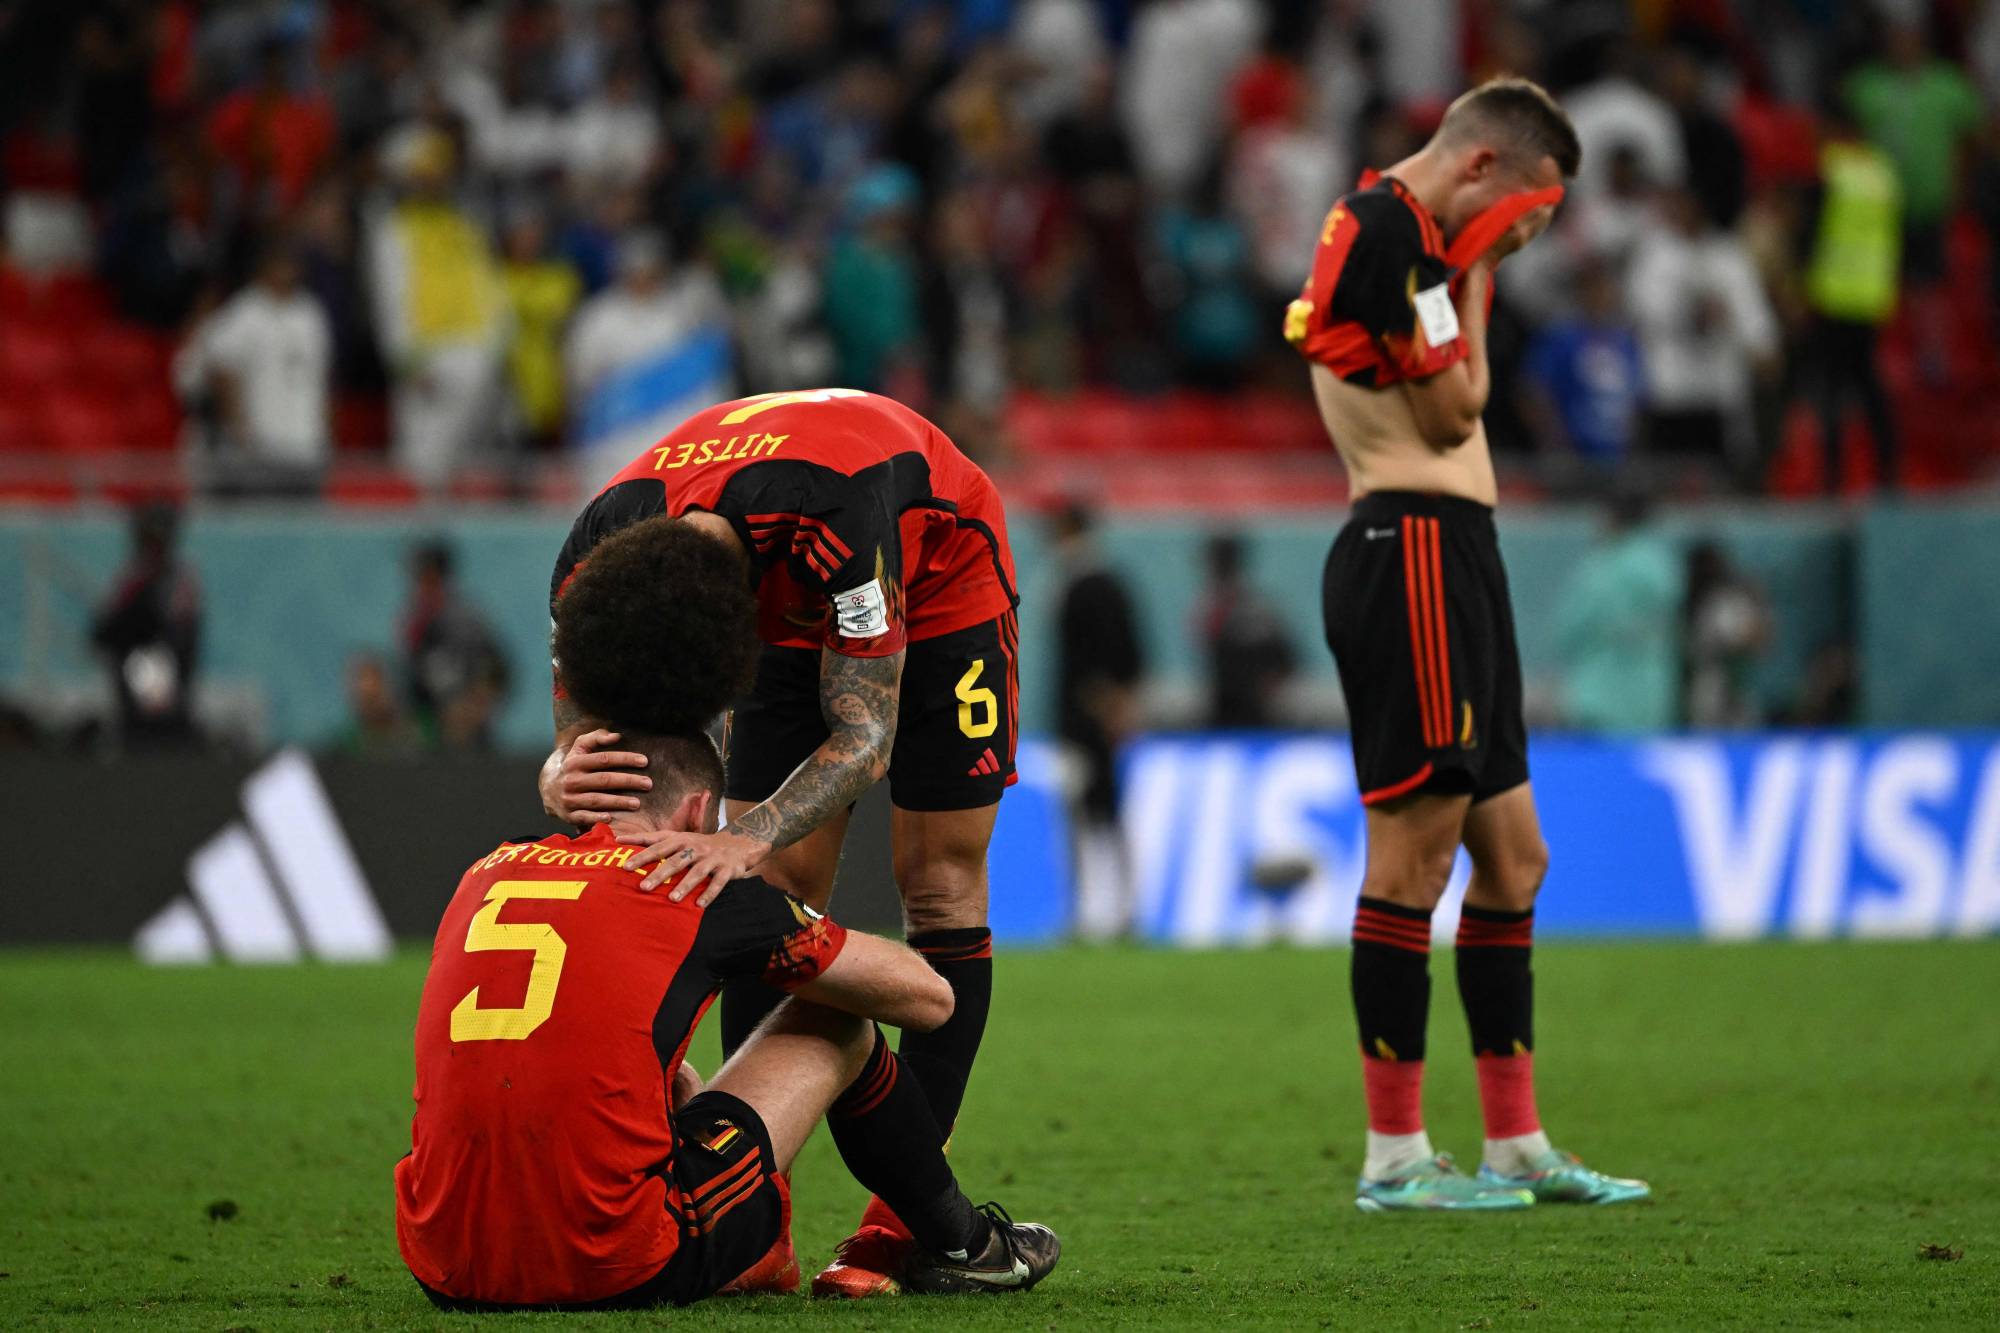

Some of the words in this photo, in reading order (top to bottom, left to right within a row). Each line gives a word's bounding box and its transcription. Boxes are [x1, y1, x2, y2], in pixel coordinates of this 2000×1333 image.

[654, 432, 790, 471] WITSEL
[955, 659, 998, 739] 6
[471, 843, 672, 884] VERTONGH
[450, 880, 589, 1042] 5
